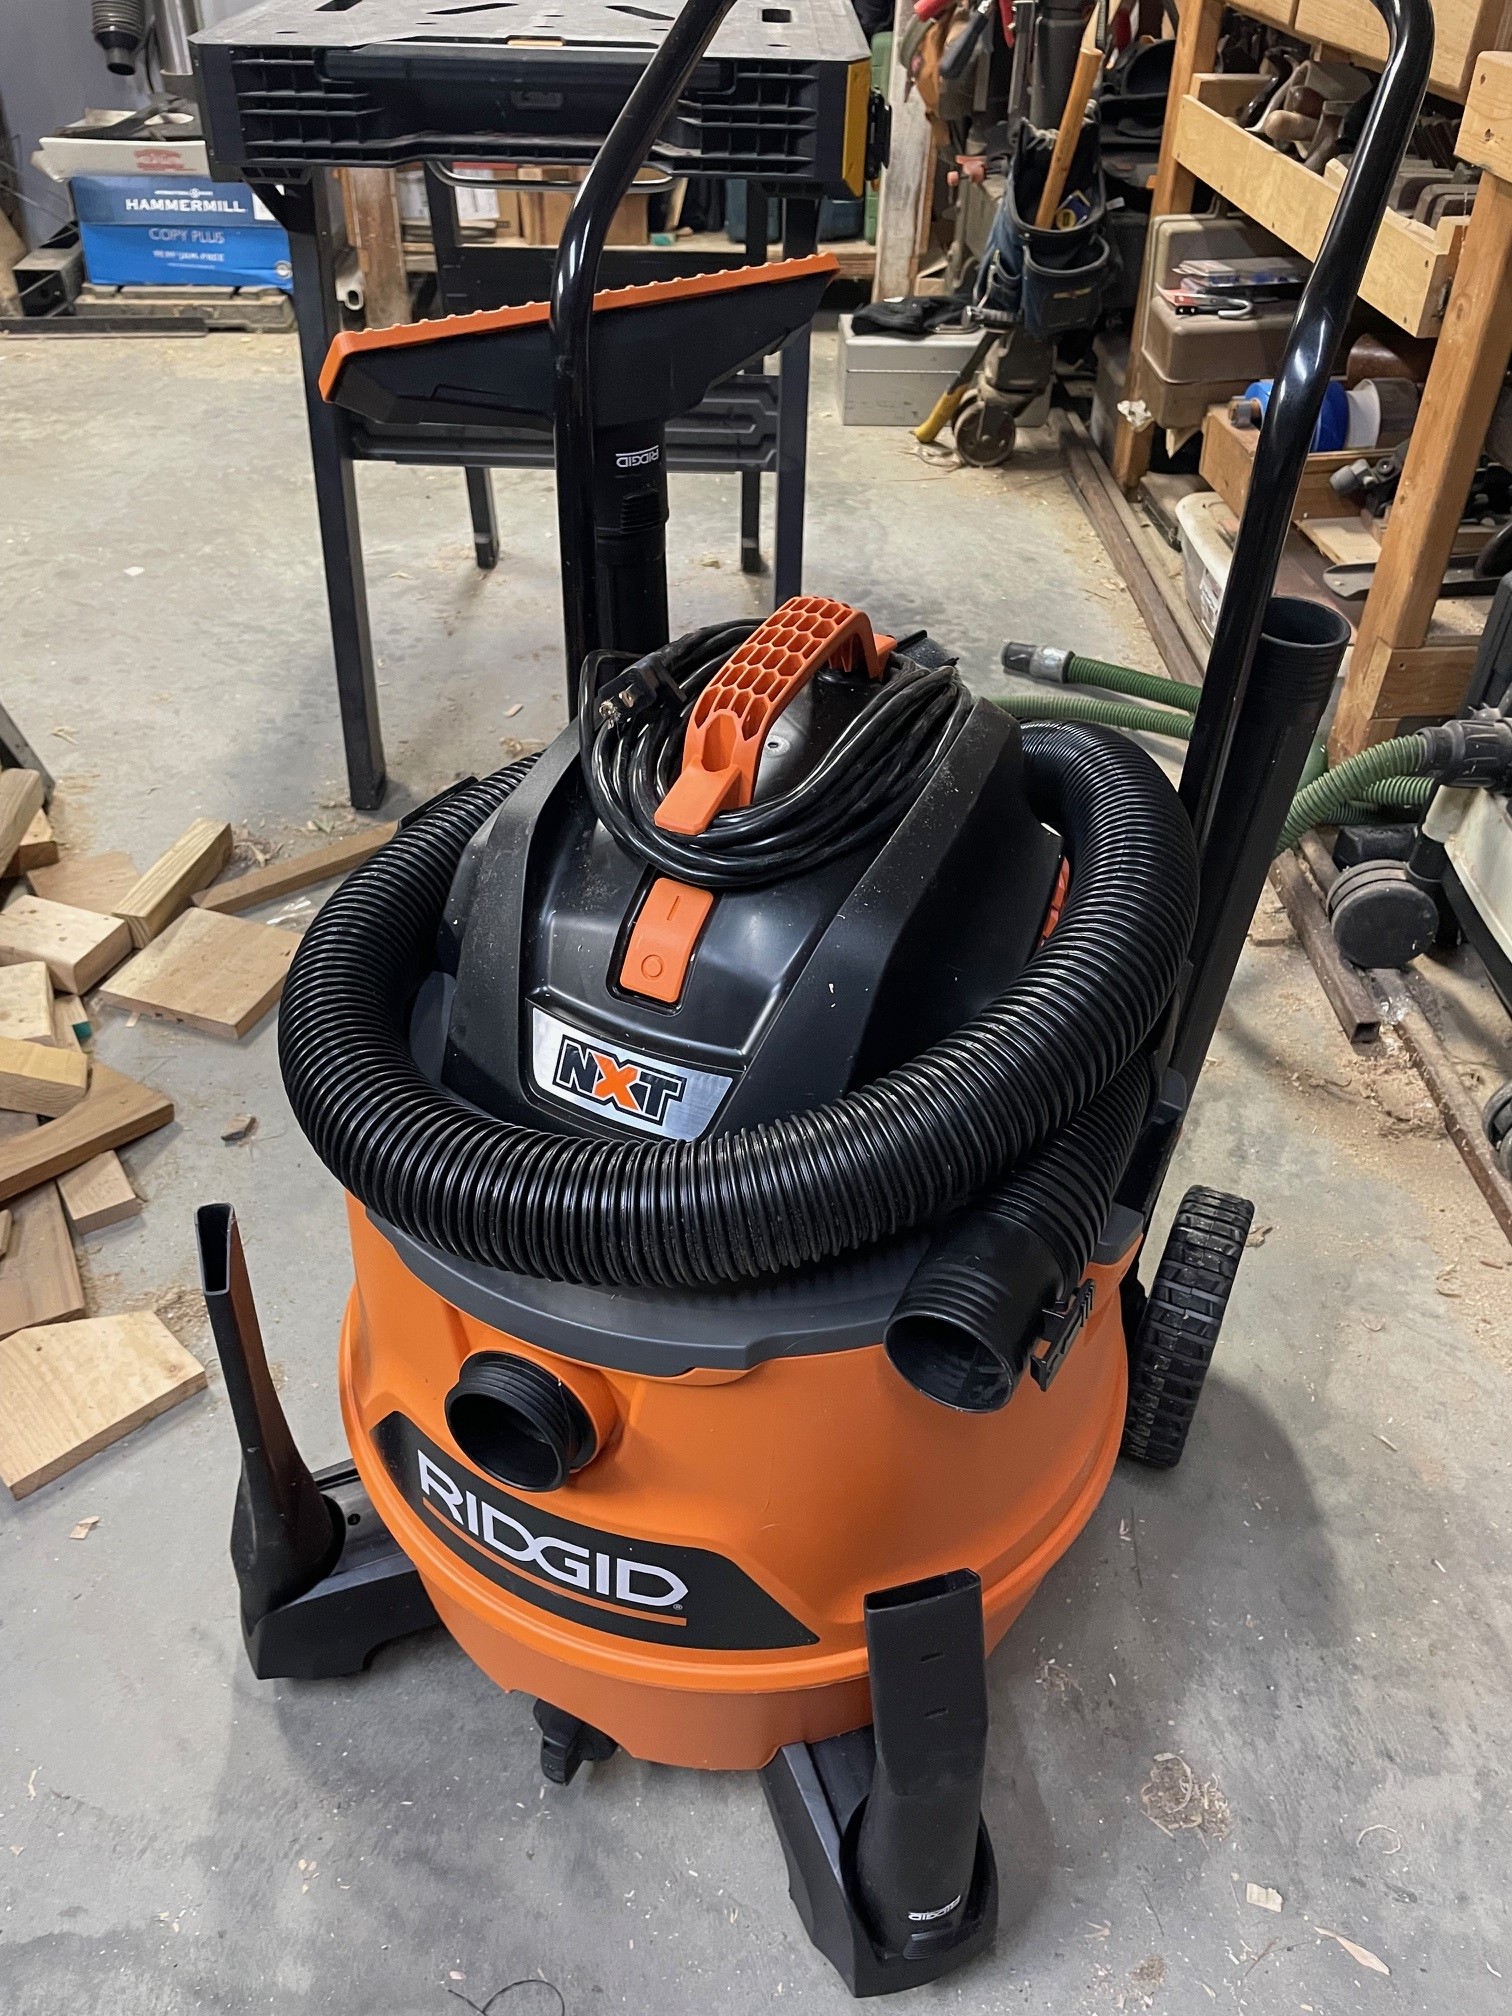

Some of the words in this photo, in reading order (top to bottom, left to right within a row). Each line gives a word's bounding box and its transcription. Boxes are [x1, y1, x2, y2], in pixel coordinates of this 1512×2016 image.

[125, 198, 246, 213] HAMMERMILL
[149, 228, 188, 242] COPY
[191, 230, 226, 244] PLUS
[616, 449, 659, 468] RIDGID
[553, 1035, 687, 1126] NXT
[418, 1449, 689, 1606] RIDGID
